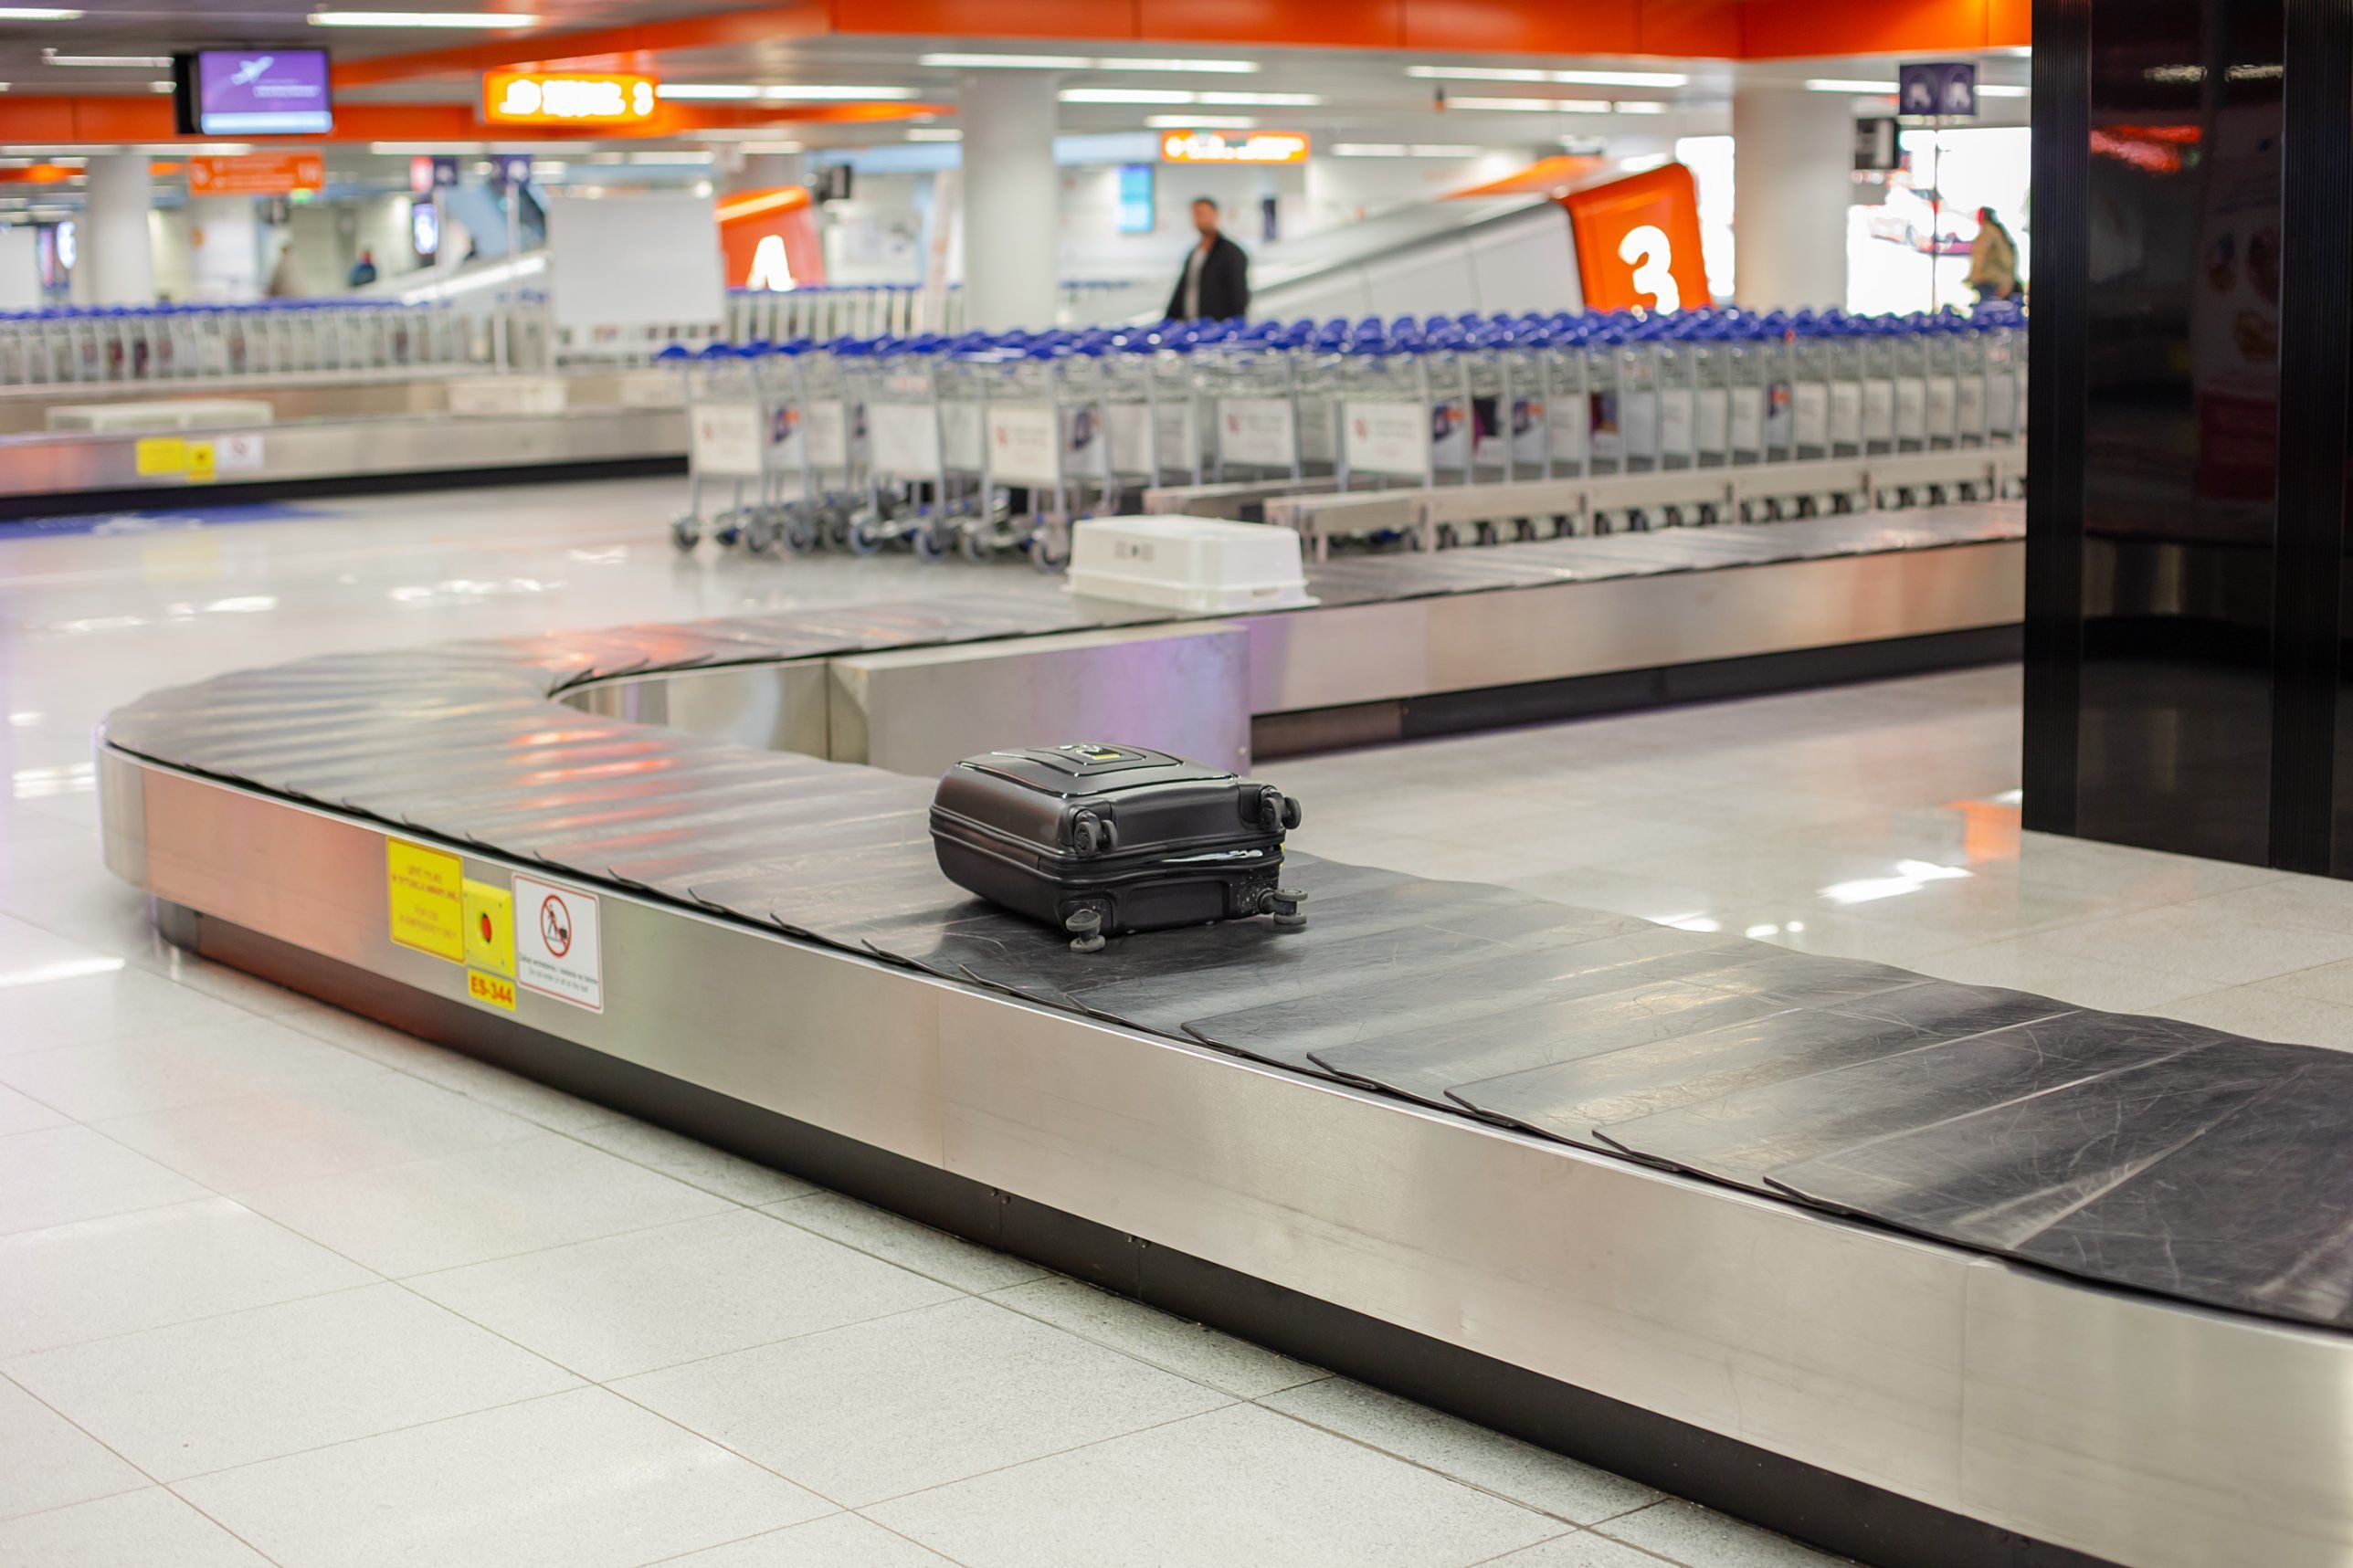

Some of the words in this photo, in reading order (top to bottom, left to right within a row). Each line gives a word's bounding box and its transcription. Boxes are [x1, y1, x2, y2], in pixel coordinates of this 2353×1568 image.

[746, 235, 797, 291] A
[1618, 226, 1680, 314] 3
[470, 975, 512, 1004] ES-344
